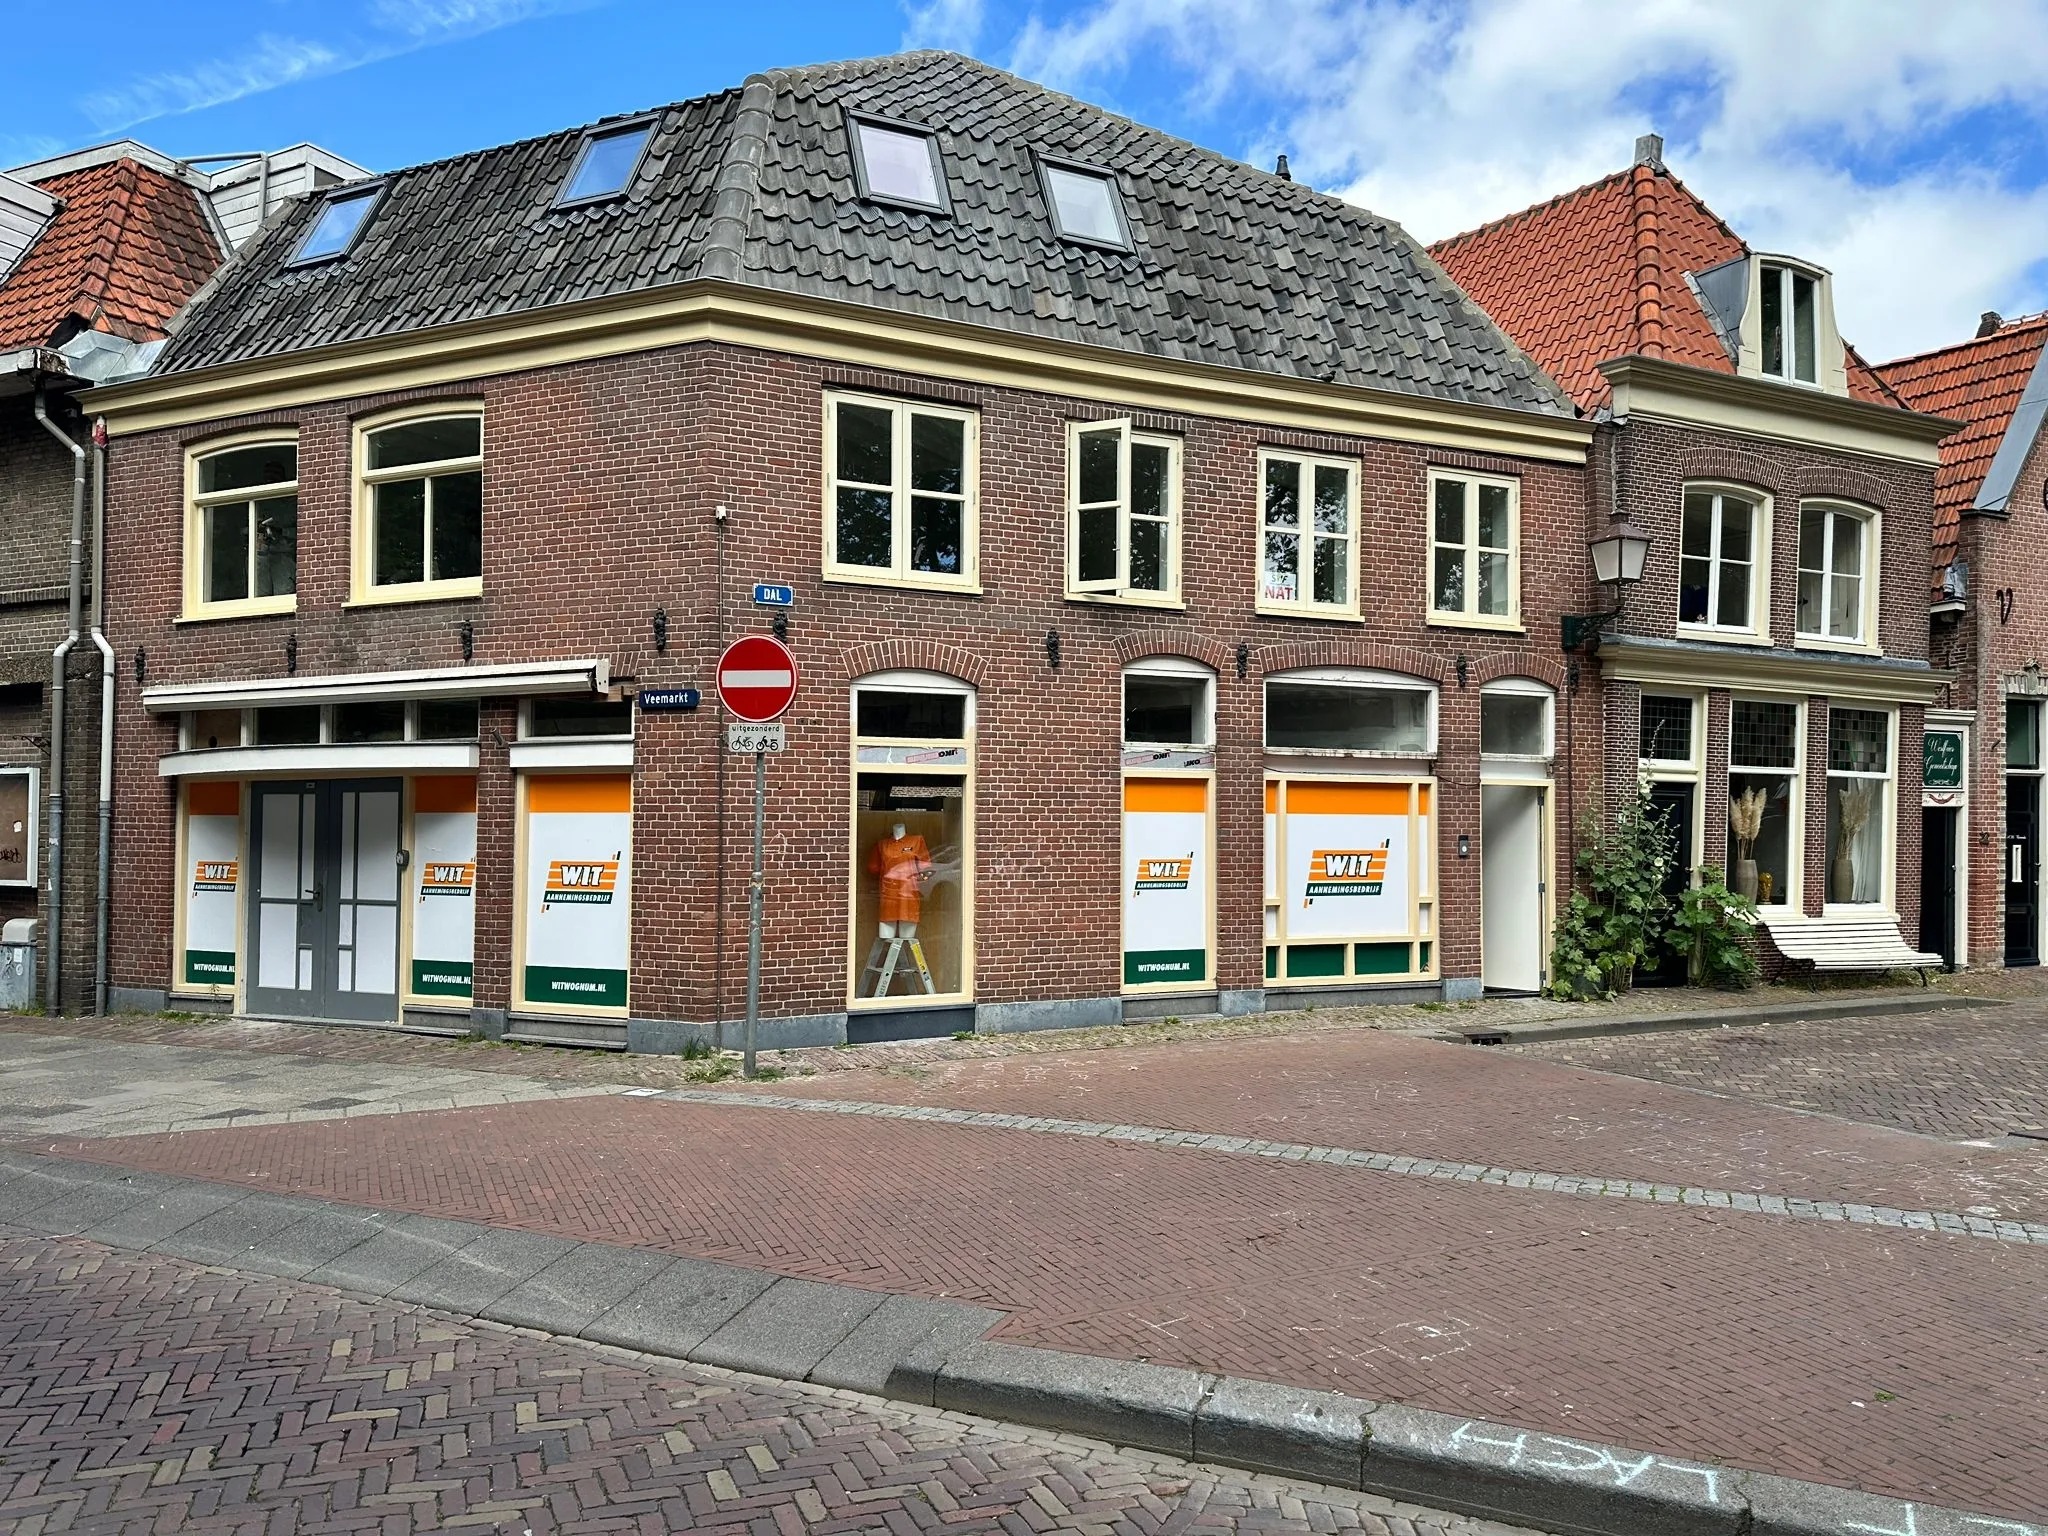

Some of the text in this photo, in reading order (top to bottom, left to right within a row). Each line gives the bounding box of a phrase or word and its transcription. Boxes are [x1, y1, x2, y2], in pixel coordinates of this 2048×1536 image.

[763, 588, 783, 601] DAL
[1264, 585, 1293, 600] NAT
[644, 691, 689, 705] Veemarkt
[731, 724, 780, 734] uitgezonderd
[204, 864, 230, 879] WIT
[1148, 861, 1181, 878] WIT
[1324, 853, 1373, 878] WIT
[433, 865, 466, 883] WIT
[560, 864, 605, 887] WIT
[1308, 885, 1380, 894] AANNEMINGSBEDRIJF
[545, 892, 611, 902] AANNEMINGSBEDRIJF
[1137, 962, 1191, 972] WITWOGNUM.NL
[422, 973, 472, 985] WITWOGNUM.NL
[551, 980, 607, 993] WITWOGNUM.NL
